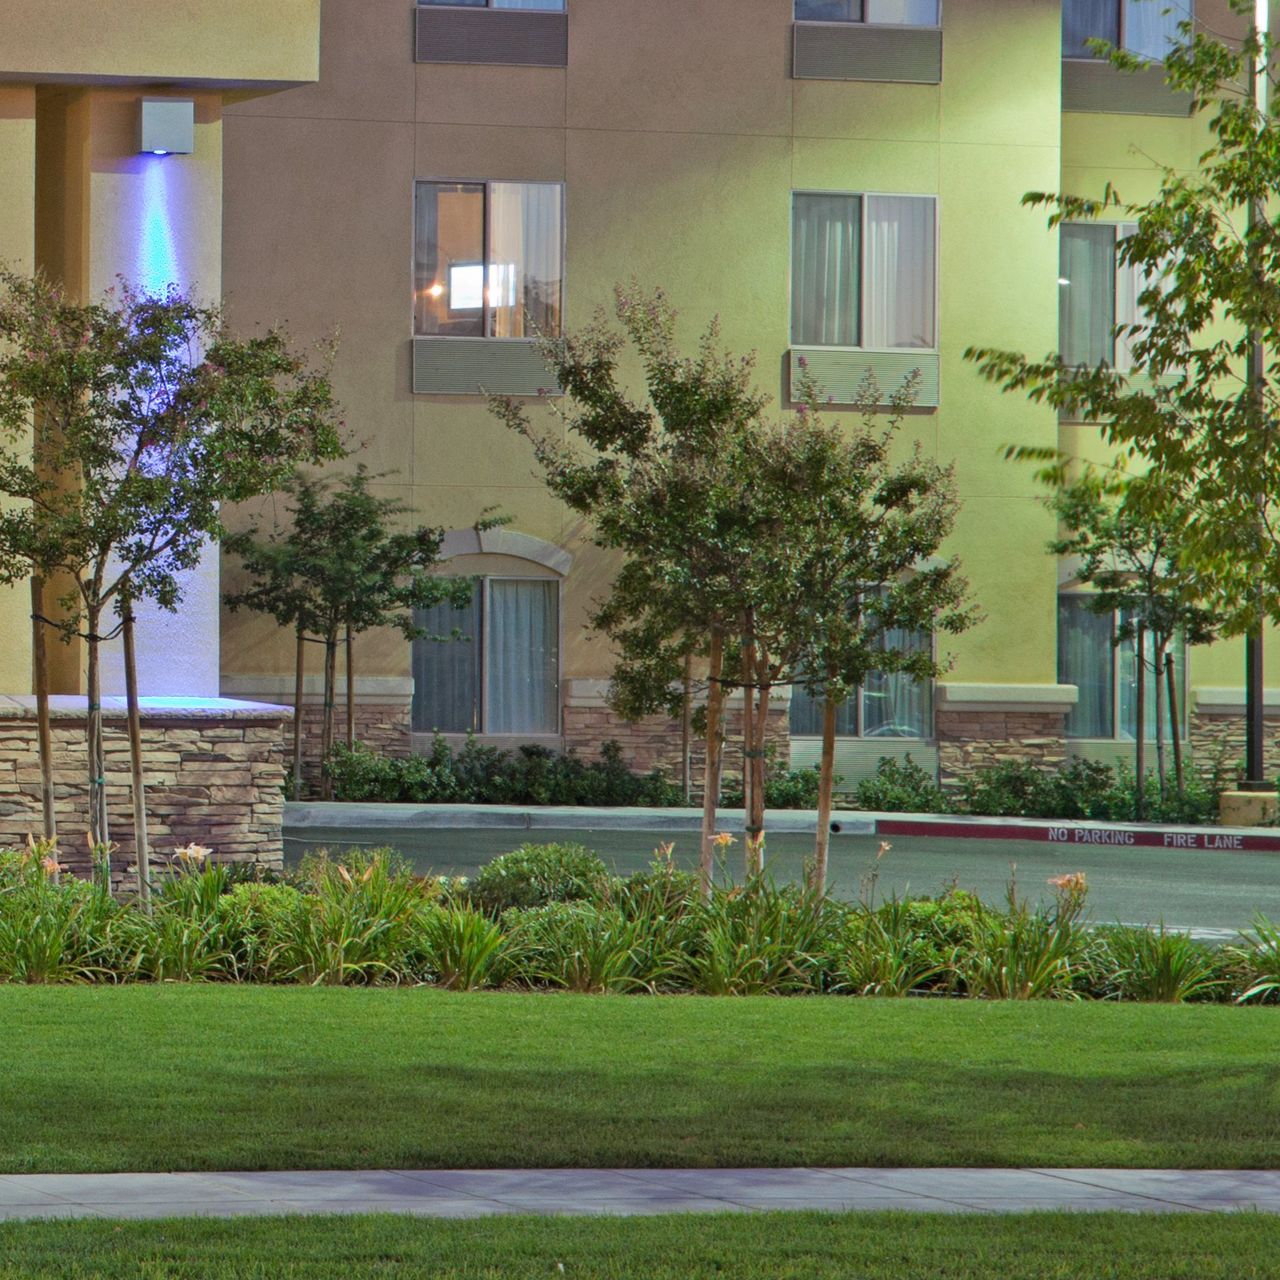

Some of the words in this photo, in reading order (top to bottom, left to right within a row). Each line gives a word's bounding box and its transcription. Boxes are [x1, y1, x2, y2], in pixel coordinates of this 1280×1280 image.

[1048, 826, 1068, 841] NO
[1074, 829, 1135, 845] PARKING
[1163, 833, 1197, 847] FIRE
[1204, 834, 1243, 849] LANE
